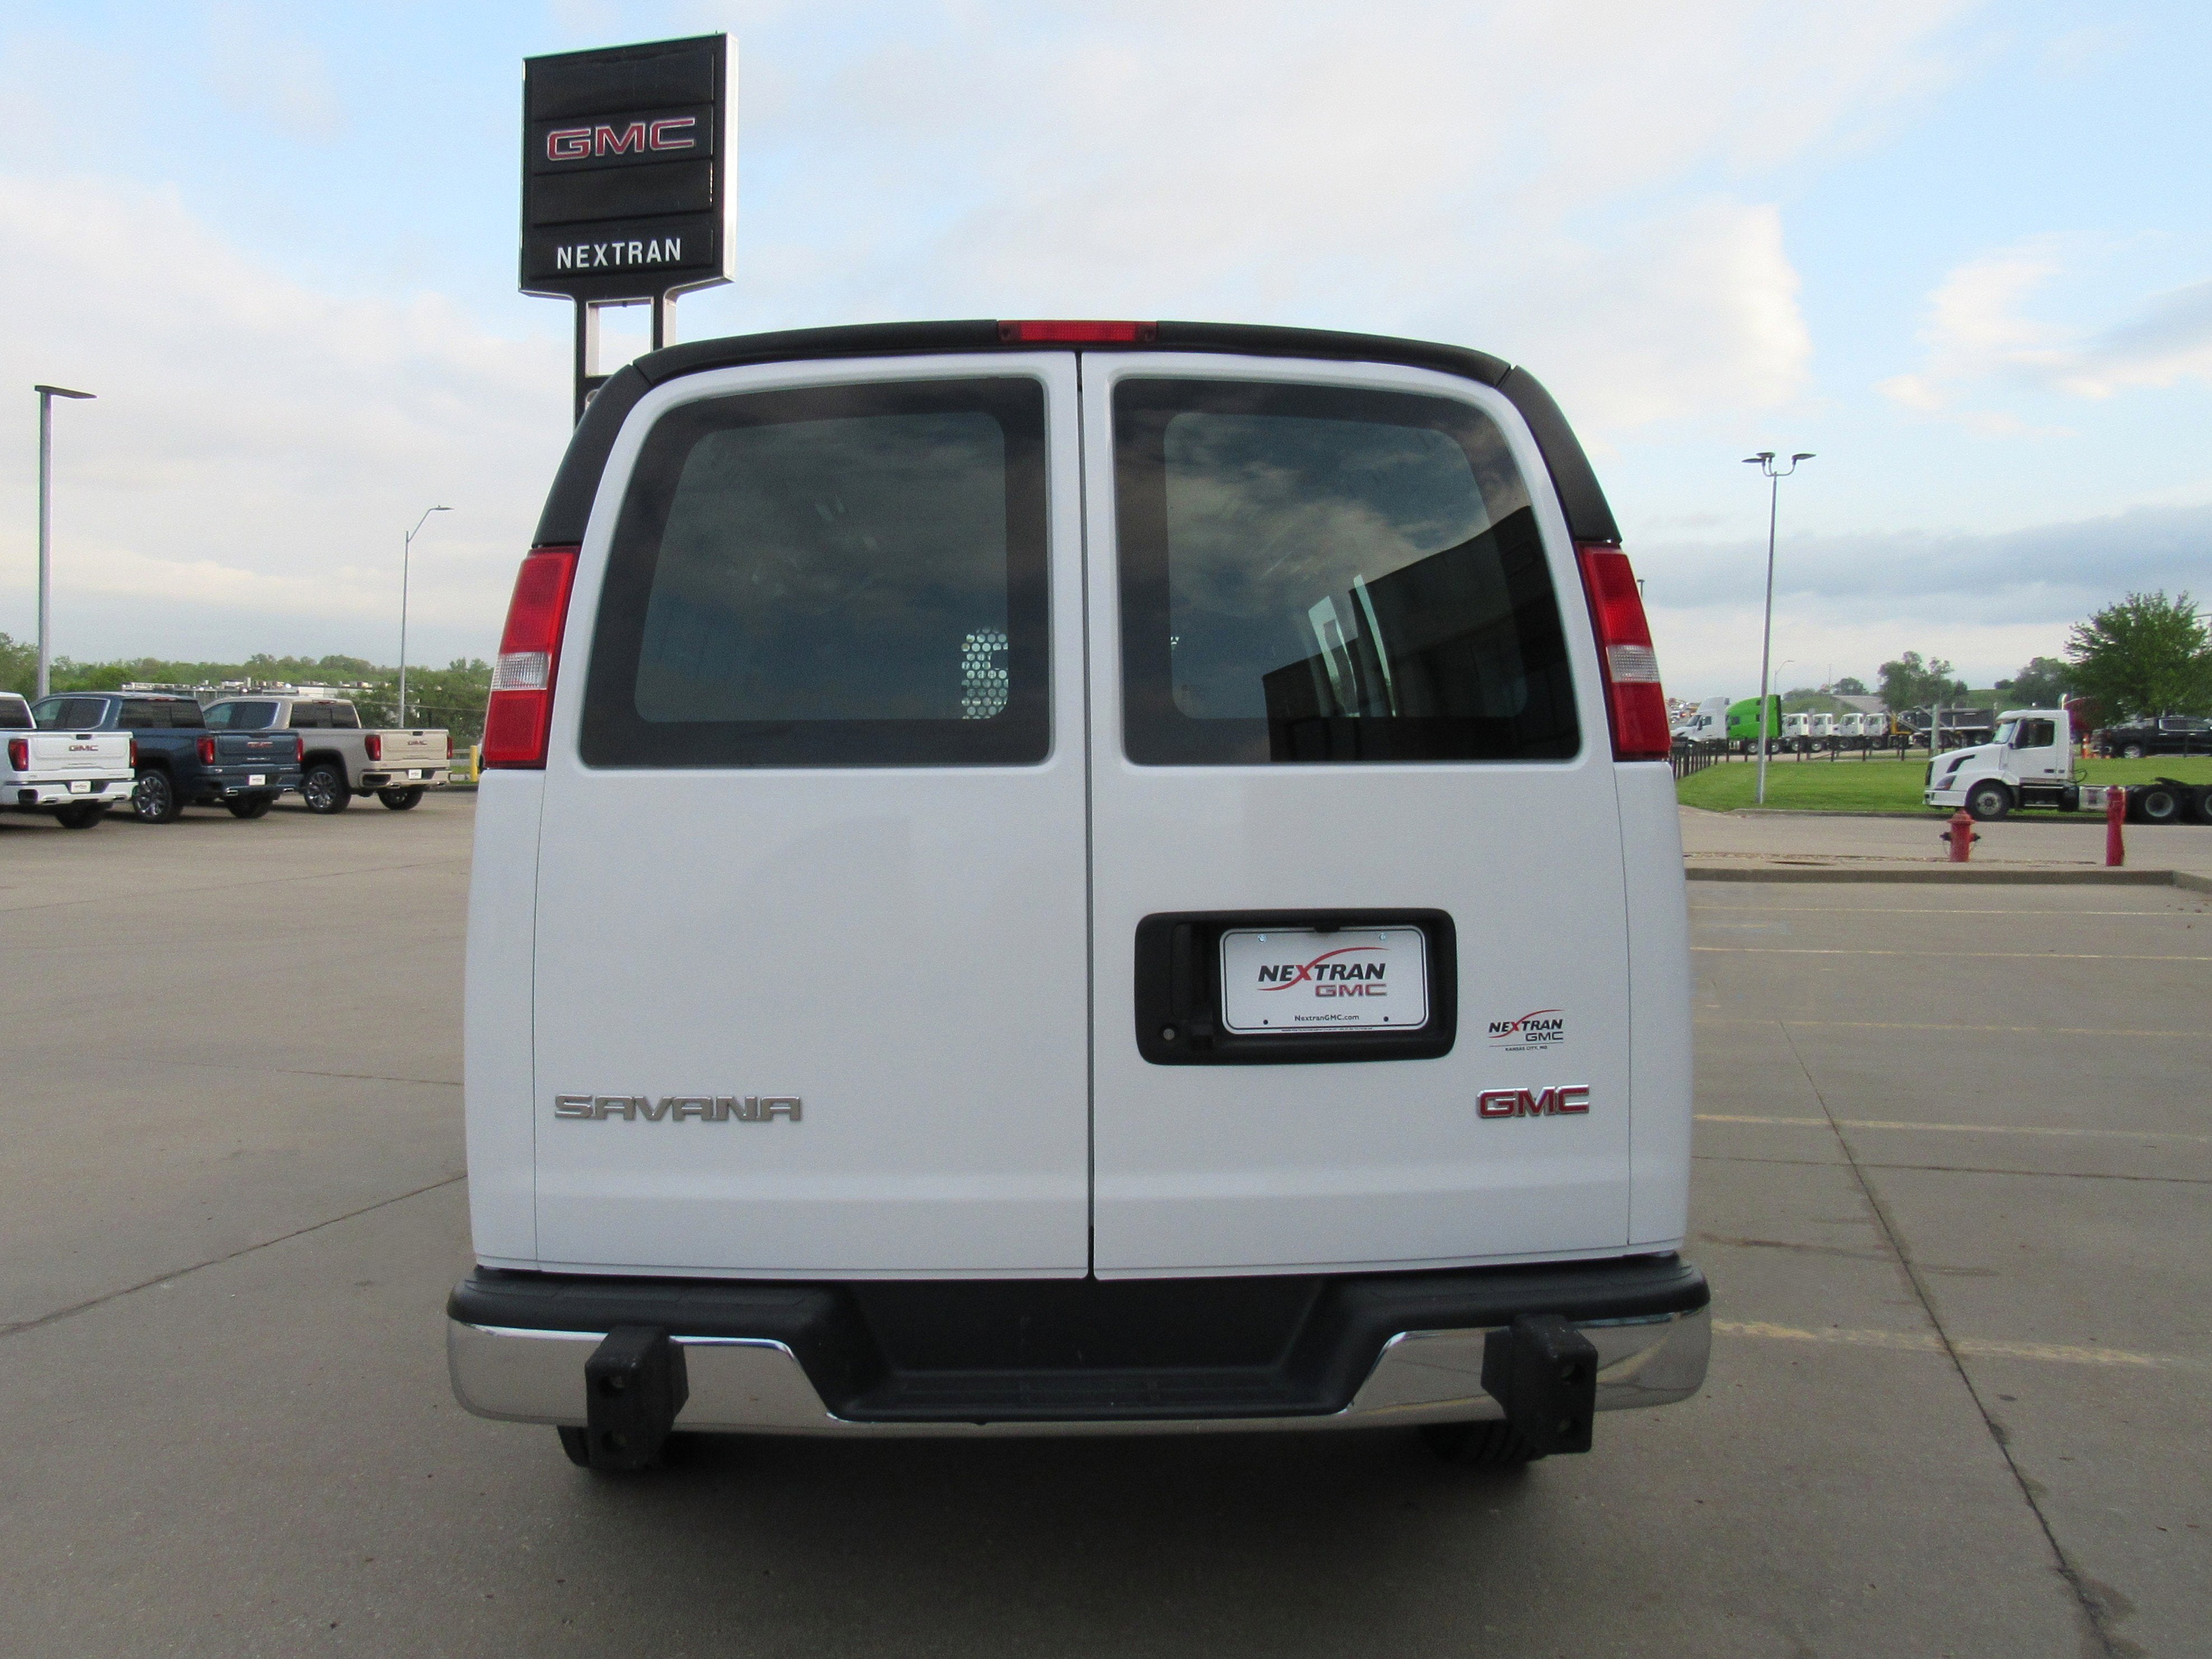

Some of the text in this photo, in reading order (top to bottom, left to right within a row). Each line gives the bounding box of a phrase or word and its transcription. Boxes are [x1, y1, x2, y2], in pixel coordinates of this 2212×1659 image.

[547, 118, 695, 161] GMC
[557, 238, 681, 269] NEXTRAN
[1258, 963, 1386, 982] NEXTRAN
[1315, 983, 1387, 997] GMC
[1488, 1019, 1563, 1033] NEXTRAN
[1525, 1032, 1564, 1041] GMC
[555, 1094, 802, 1121] SAVANA
[1477, 1084, 1589, 1119] GMC
